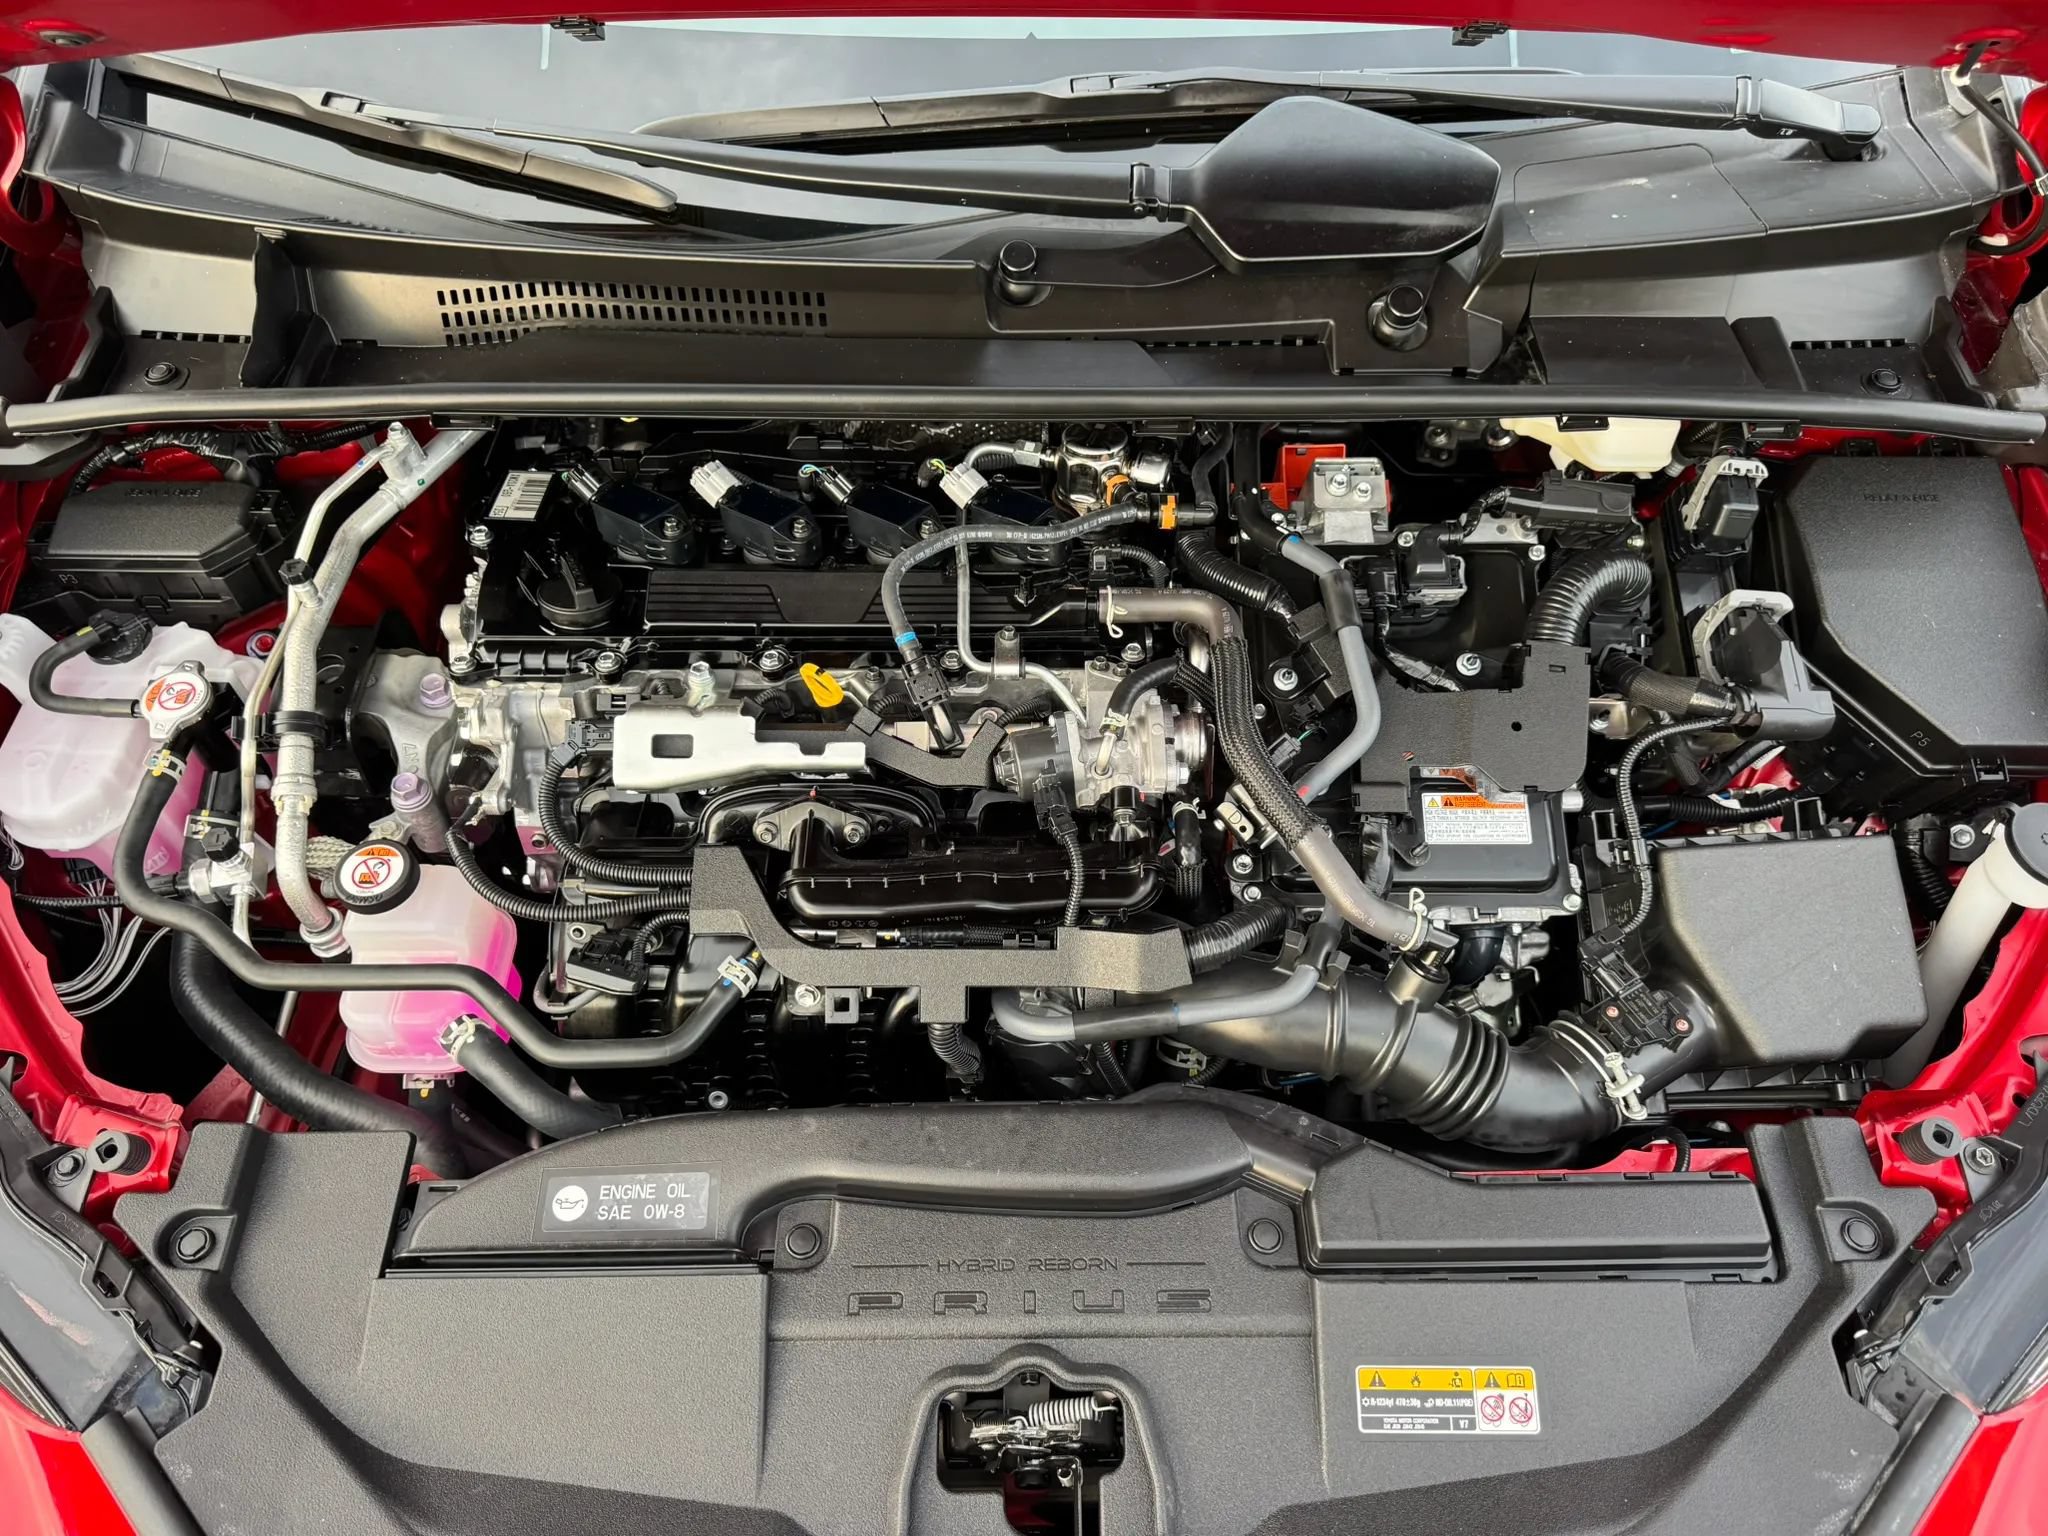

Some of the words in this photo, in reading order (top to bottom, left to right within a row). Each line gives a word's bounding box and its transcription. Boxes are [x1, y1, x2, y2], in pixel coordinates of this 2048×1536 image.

[59, 574, 79, 585] P3
[1910, 730, 1931, 747] P5
[599, 1184, 657, 1200] ENGINE
[666, 1183, 691, 1199] OIL
[597, 1204, 633, 1221] SAE
[936, 1258, 1016, 1273] HYBRID
[1027, 1257, 1118, 1272] REBORN
[848, 1289, 1213, 1316] PRIUS
